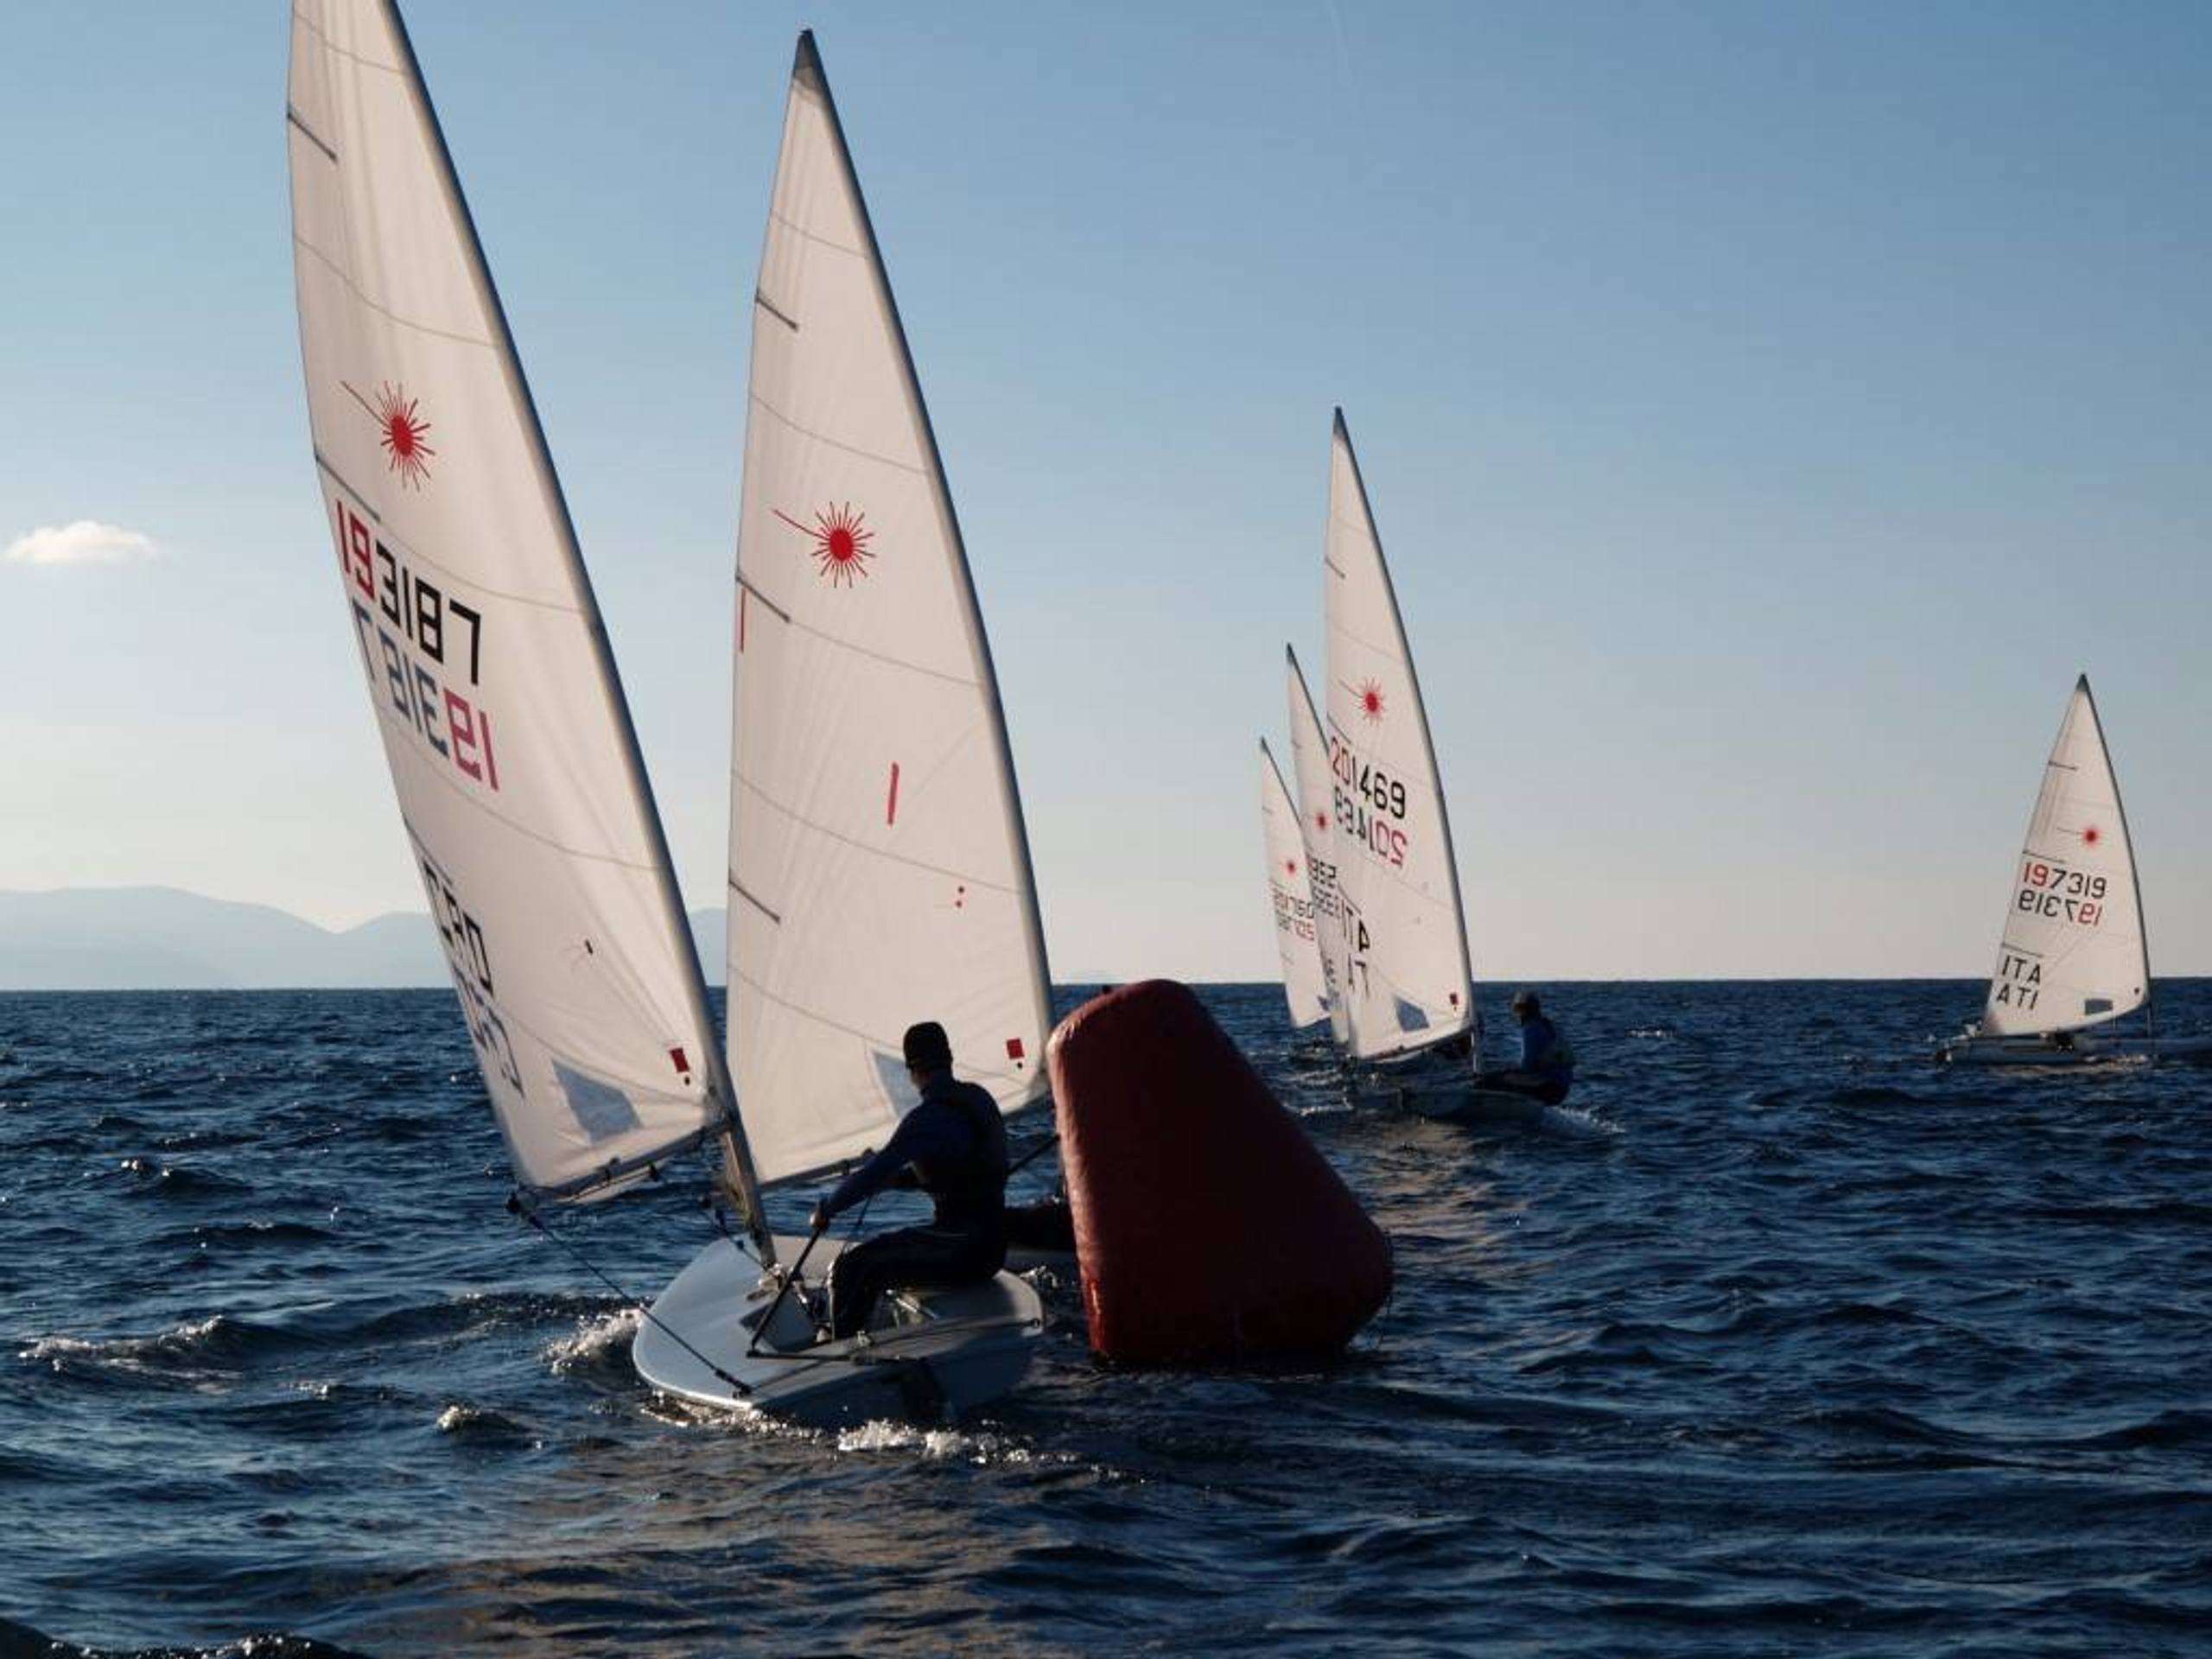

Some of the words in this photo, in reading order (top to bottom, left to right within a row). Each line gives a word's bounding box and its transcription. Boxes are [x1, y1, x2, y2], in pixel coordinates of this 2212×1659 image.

[337, 499, 481, 685] 193187
[1331, 736, 1406, 820] 201469
[2023, 862, 2107, 899] 197319
[2000, 955, 2043, 984] ITA
